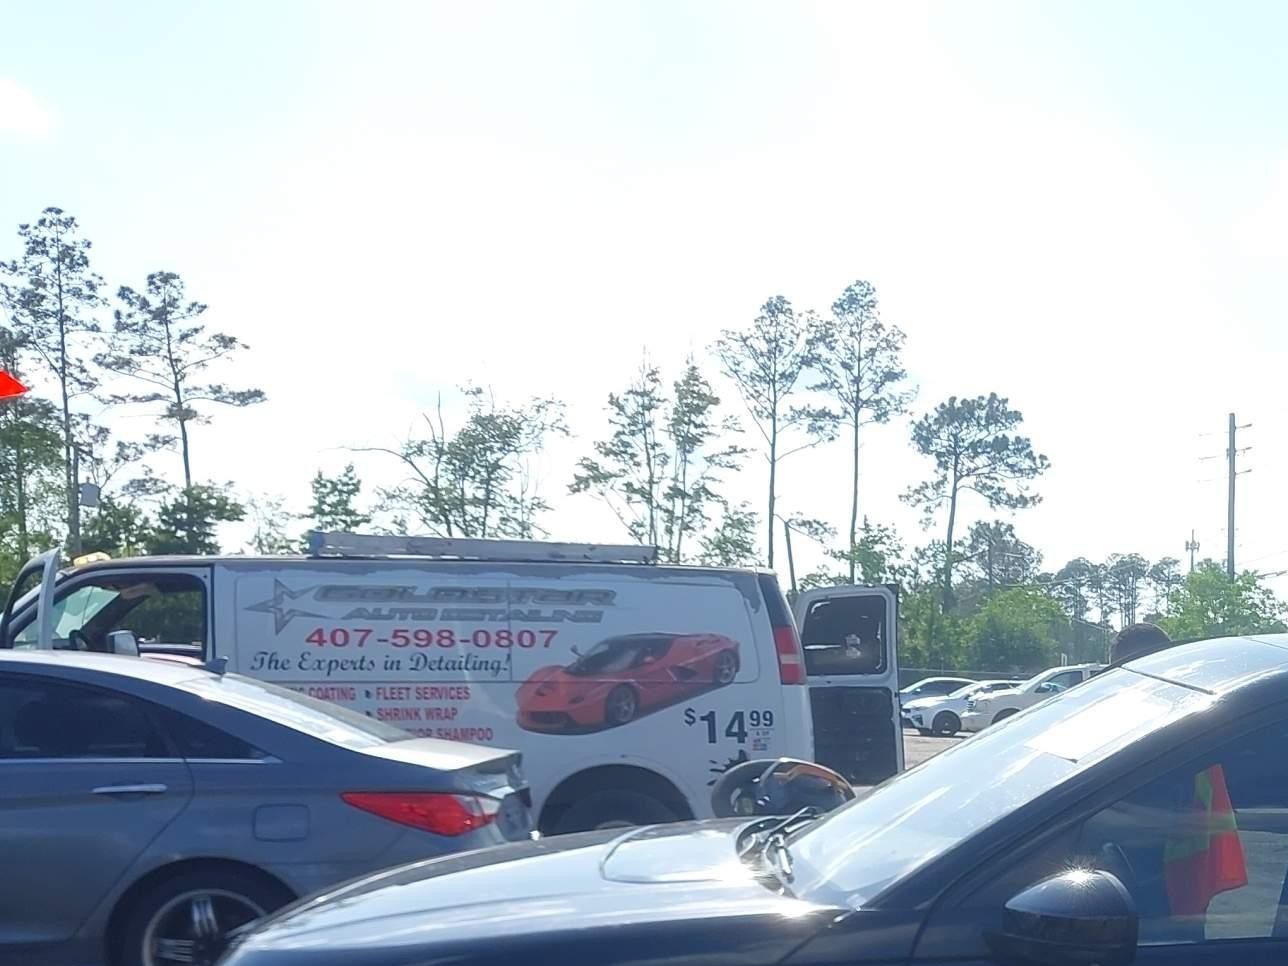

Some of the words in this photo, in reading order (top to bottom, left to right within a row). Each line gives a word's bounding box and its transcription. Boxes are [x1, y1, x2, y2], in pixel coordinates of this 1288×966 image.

[340, 607, 438, 621] AUTO
[305, 628, 559, 648] 407-598-0807
[250, 651, 291, 671] The
[297, 651, 376, 677] Experts
[384, 655, 401, 671] in
[409, 652, 511, 676] Detailing!
[376, 687, 411, 700] FLEET
[415, 687, 471, 700] SERVICES
[376, 708, 422, 721] SHRINK
[425, 708, 458, 721] WRAP
